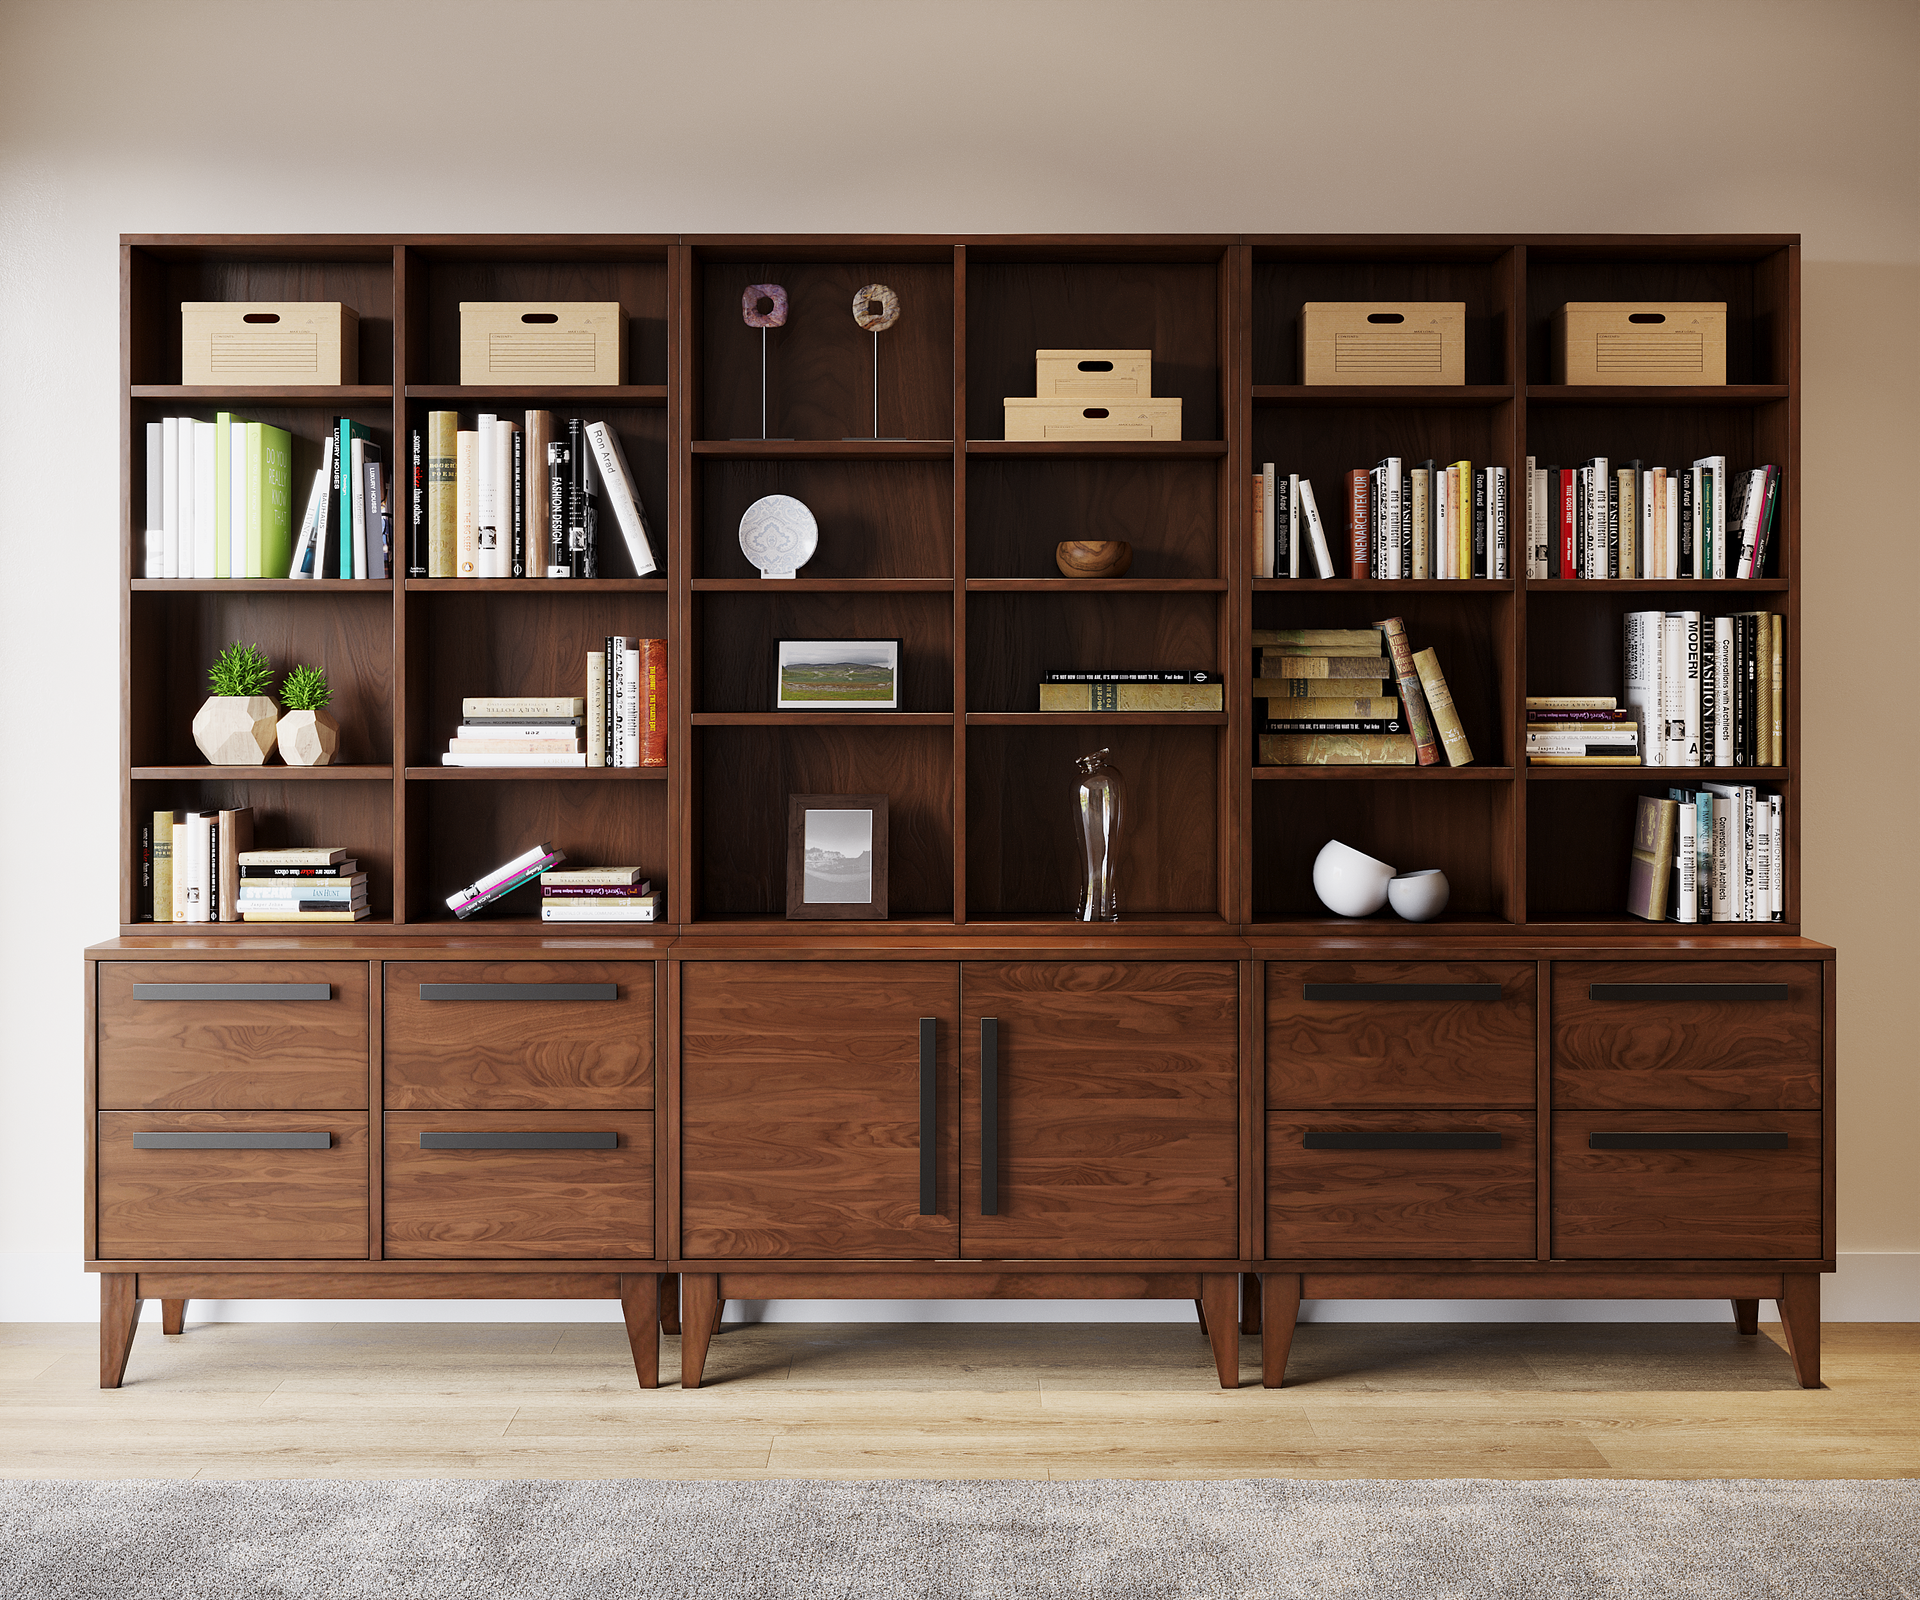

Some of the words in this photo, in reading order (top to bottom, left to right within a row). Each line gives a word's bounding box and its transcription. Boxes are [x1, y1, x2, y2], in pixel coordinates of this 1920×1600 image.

[413, 436, 421, 453] some
[593, 429, 605, 449] Ron
[601, 452, 616, 474] Arad
[267, 447, 275, 465] DO
[276, 450, 288, 468] YOU
[463, 445, 471, 474] RAYMOND
[268, 468, 288, 488] REALLY
[413, 466, 423, 488] sicker
[1279, 480, 1288, 494] Ron
[1476, 474, 1484, 488] Ron
[1683, 474, 1691, 488] Ron
[271, 489, 288, 506] KNOW
[413, 488, 423, 503] than
[463, 475, 471, 507] CHANDLER
[552, 477, 562, 512] FASHION
[1390, 490, 1400, 502] arts
[1403, 480, 1411, 500] THE
[1476, 489, 1484, 507] Arad
[1597, 490, 1606, 502] arts
[1610, 480, 1619, 500] THE
[1683, 489, 1691, 507] Arad
[319, 492, 328, 529] BAUHAUS
[1279, 495, 1288, 511] Arad
[1497, 474, 1505, 549] ARCHITECTURE
[274, 509, 287, 526] THAT
[301, 507, 315, 537] LIVING
[413, 505, 423, 525] others
[463, 512, 471, 524] THE
[1279, 514, 1287, 524] No
[1354, 476, 1367, 564] INNENARCHITEKTUR
[1403, 501, 1411, 546] FASHION
[1476, 510, 1484, 521] No
[1610, 501, 1619, 546] FASHION
[1683, 510, 1691, 521] No
[463, 525, 471, 534] BIG
[552, 514, 562, 544] DESIGN
[1278, 524, 1288, 555] Discipline
[1390, 511, 1401, 548] architecture
[1475, 522, 1484, 555] Discipline
[1597, 511, 1607, 548] architecture
[1682, 522, 1691, 555] Discipline
[463, 536, 471, 552] SLEEP
[1403, 548, 1411, 578] BOOK
[1610, 548, 1619, 578] BOOK
[1703, 618, 1714, 648] THE
[1688, 620, 1698, 679] MODERN
[1722, 639, 1730, 689] Conversations
[627, 681, 637, 693] arts
[1703, 652, 1714, 717] FASHION
[1722, 690, 1730, 705] with
[627, 702, 638, 737] architecture
[1722, 707, 1730, 741] Architects
[1689, 742, 1698, 755] A
[1703, 721, 1714, 763] BOOK
[1700, 810, 1710, 844] IMMORTAL
[1719, 816, 1727, 858] Conversations
[1683, 836, 1695, 848] arts
[1758, 834, 1770, 846] arts
[1702, 846, 1710, 868] GAME
[1719, 858, 1727, 871] with
[1683, 856, 1695, 892] architecture
[1758, 855, 1770, 891] architecture
[246, 887, 293, 899] STEAM
[312, 889, 323, 897] IAN
[324, 889, 340, 897] HUNT
[1719, 871, 1727, 901] Architects
